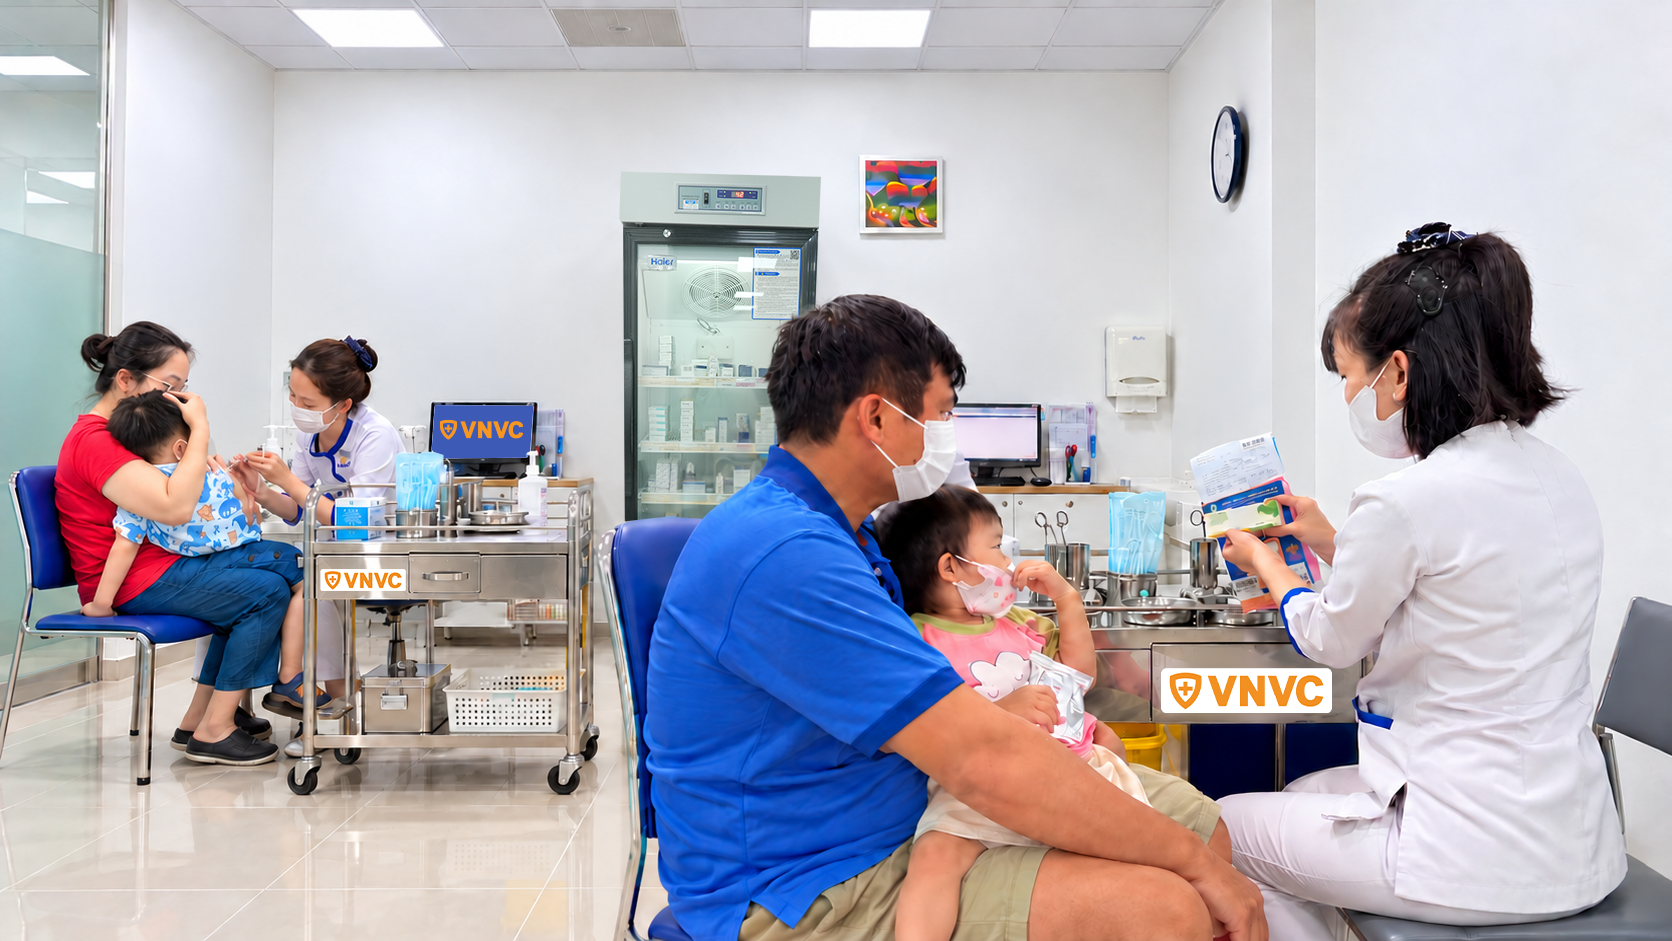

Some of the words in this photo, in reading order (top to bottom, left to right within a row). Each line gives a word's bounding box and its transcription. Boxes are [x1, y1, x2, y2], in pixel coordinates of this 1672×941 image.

[651, 257, 674, 266] Haier
[460, 421, 524, 439] VNVC
[343, 572, 402, 589] VNVC
[1207, 675, 1324, 708] VNVC
